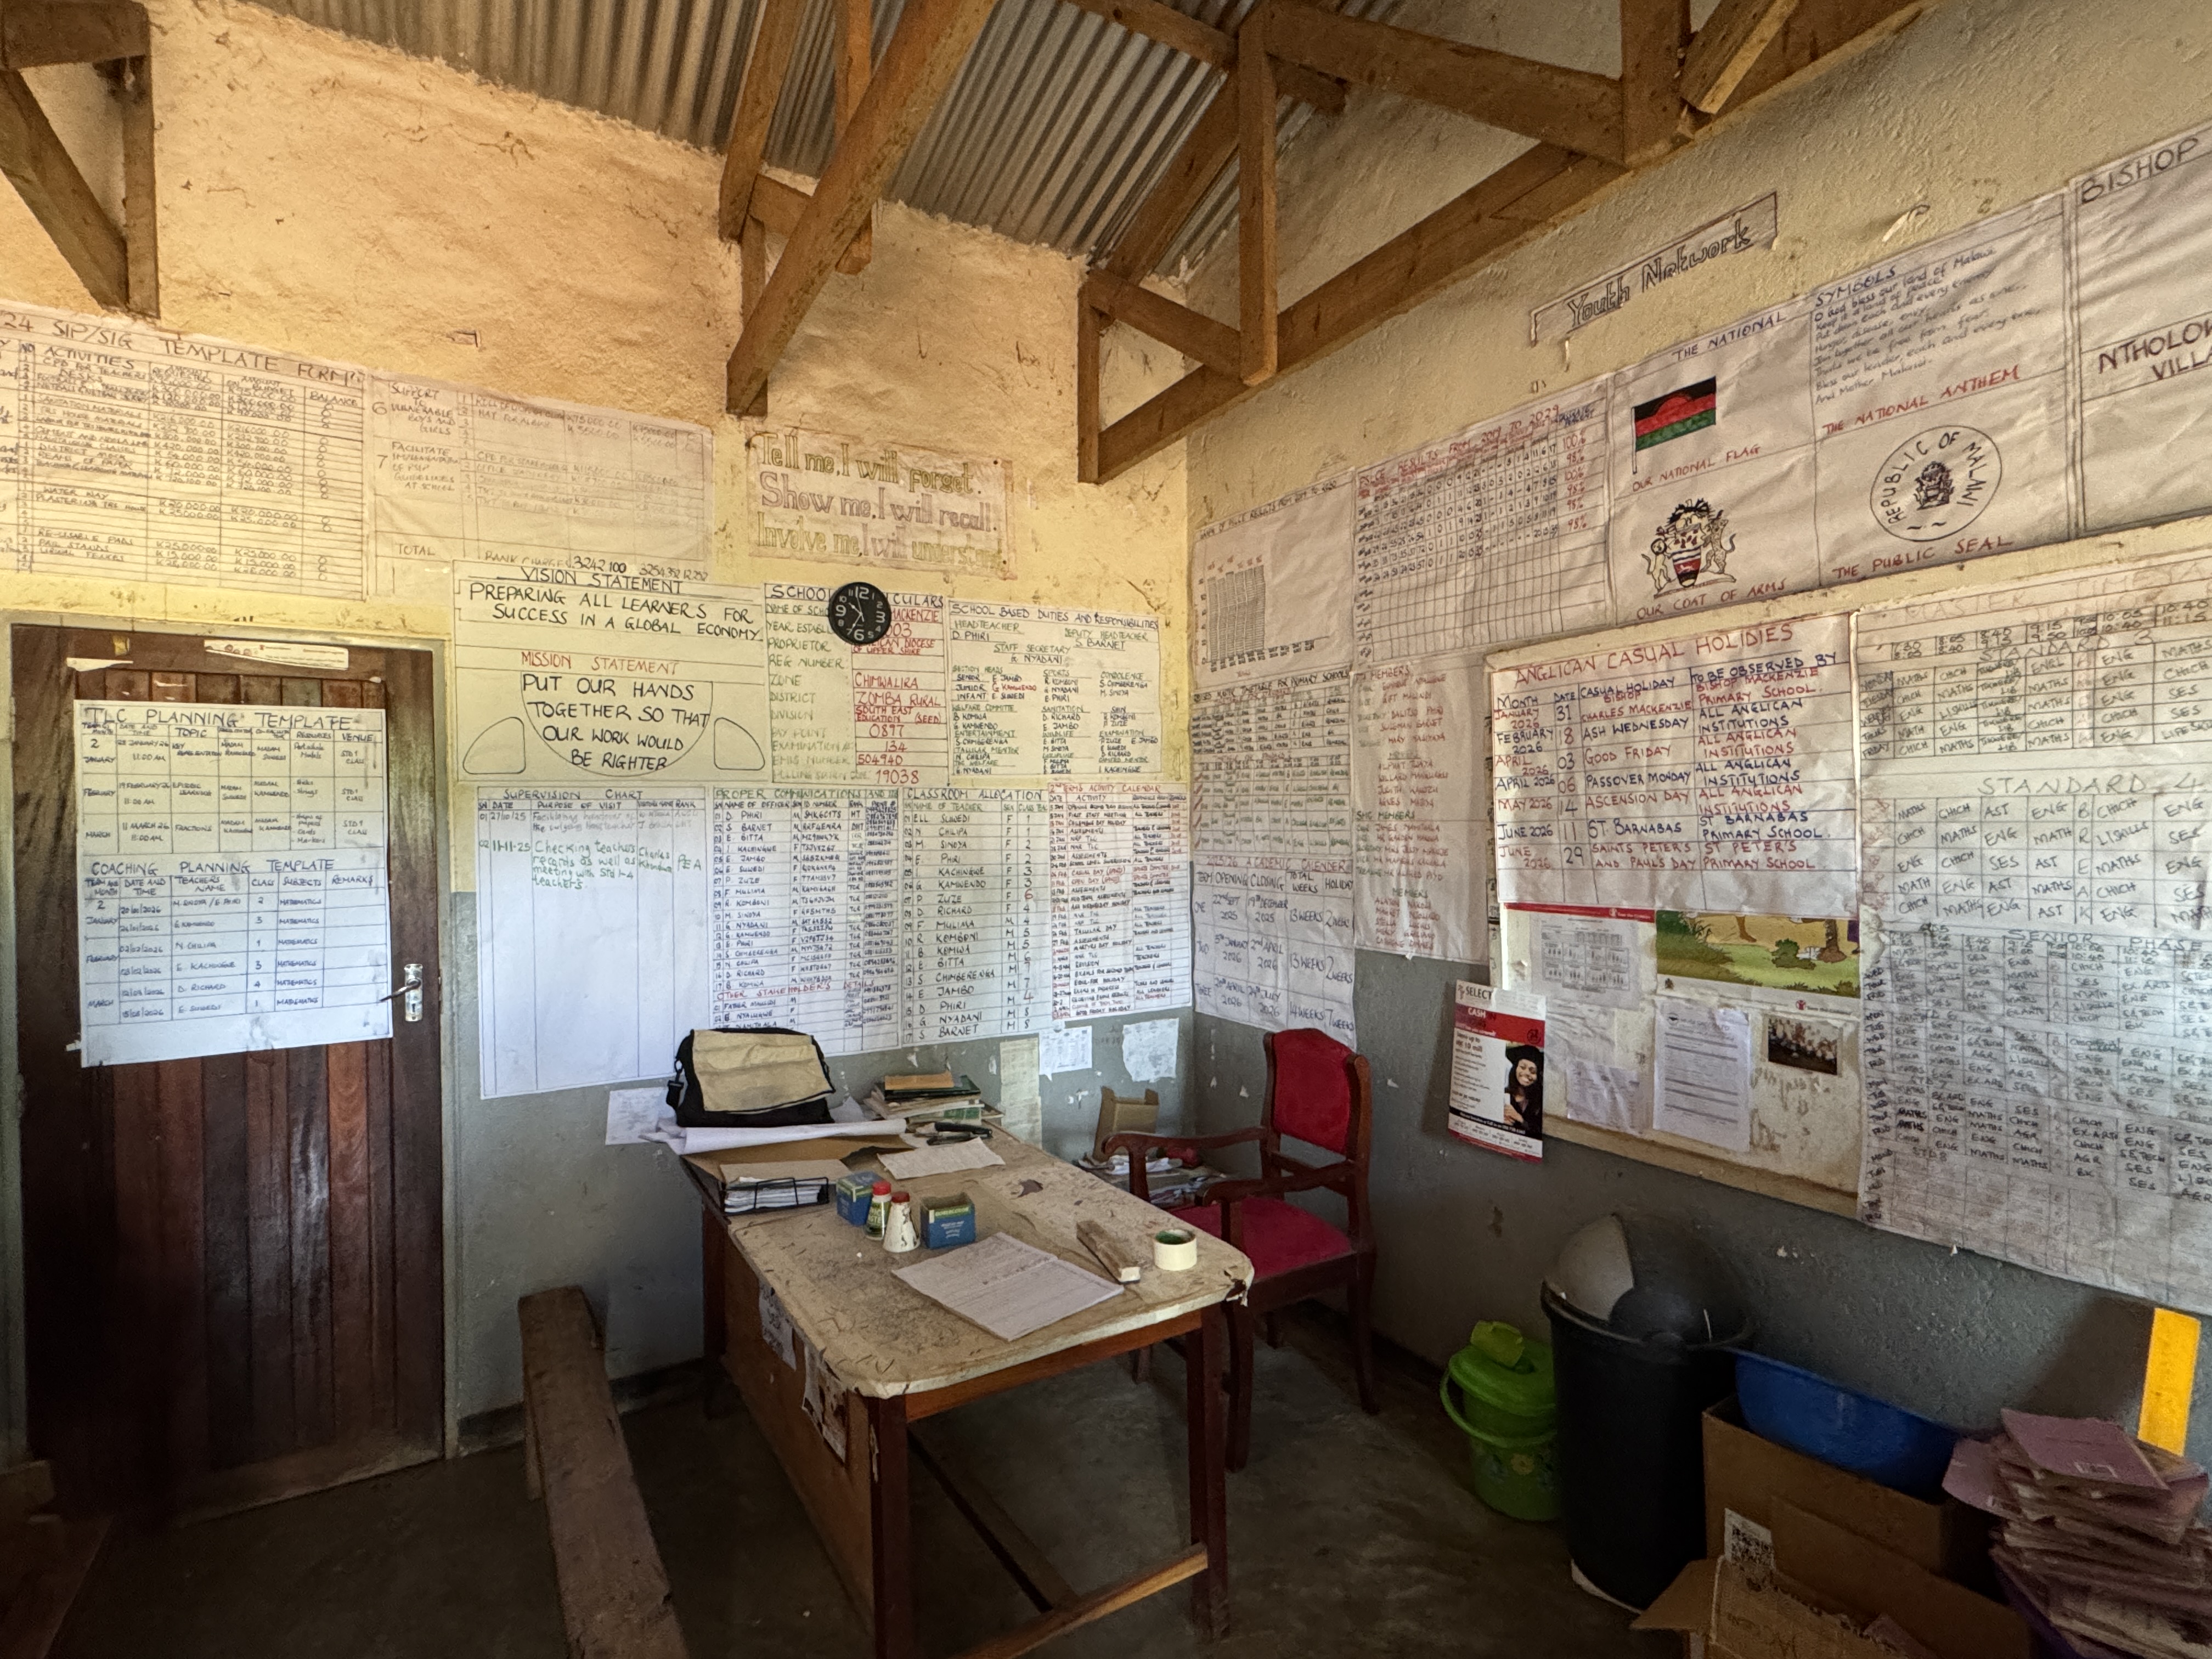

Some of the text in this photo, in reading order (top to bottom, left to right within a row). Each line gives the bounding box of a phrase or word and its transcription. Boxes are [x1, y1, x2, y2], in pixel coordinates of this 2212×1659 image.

[2081, 137, 2198, 204] BISHOP
[1567, 217, 1751, 328] Youth Network
[1672, 265, 1896, 361] THE NATIONAL SYMBOLS
[161, 338, 277, 370] TEMPLATE
[1822, 365, 2020, 435] THE NATIONAL ANTHEM
[757, 432, 800, 470] Tell
[855, 450, 899, 484] will
[1632, 444, 1760, 492] OUR NATIONAL FLAG
[1881, 441, 1929, 523] REPUBLIC
[1938, 431, 1960, 449] OF
[760, 471, 834, 513] Show
[890, 493, 933, 524] will
[1832, 536, 2013, 579] THE PUBLIC SEAL
[521, 566, 683, 594] VISION STATEMENT
[855, 586, 870, 600] 12
[1636, 579, 1787, 620] OUR COAT OF ARMS
[470, 583, 753, 624] PREPARING ALL LEARNERS FOR
[836, 605, 847, 617] 9
[493, 603, 568, 624] SUCCESS
[580, 613, 595, 626] IN
[605, 617, 614, 629] A
[625, 617, 681, 633] GLOBAL
[876, 611, 885, 623] 3
[951, 605, 1158, 630] SCHOOL BASED DUTIES AND RESPONSIBILITIES
[955, 620, 1019, 631] HEADTEACHER
[768, 637, 832, 652] PROPRIETOR
[854, 629, 864, 641] 6
[522, 651, 679, 675] MISSION STATEMENT
[798, 658, 845, 669] NUMBER
[1515, 624, 1793, 689] ANGLICAN CASUAL HOLIDIES
[523, 674, 695, 701] PUT OUR HANDS
[770, 672, 918, 689] ZONE CHIMWALIRA
[1498, 695, 1538, 709] MONTH
[1581, 685, 1619, 698] CASUAL
[1626, 678, 1675, 691] HOLIDAY
[1708, 668, 1724, 681] BE
[1730, 657, 1804, 677] OBSERVED
[1815, 652, 1836, 667] BY
[770, 692, 941, 707] DISTRICT ZOMBA RURAL
[85, 708, 353, 730] TLC PLANNING TEMPLATE
[527, 702, 710, 727] TOGETHER SO THAT
[892, 706, 913, 714] EAST
[915, 713, 941, 724] (SEED)
[1556, 704, 1572, 721] 31
[1629, 701, 1692, 714] MACKENZIE
[175, 728, 374, 741] TOPIC VENUE
[543, 726, 684, 751] OUR WORK WOULD
[870, 724, 904, 737] 0897
[1583, 718, 1689, 740] ASH WEDNESDAY
[885, 741, 908, 752] 134
[1584, 746, 1672, 765] GOOD FRIDAY
[571, 749, 668, 771] BE RIGHTER
[858, 754, 903, 765] 504940
[877, 769, 919, 784] 19038
[1586, 759, 1791, 788] PASSOVER MONDAY ALL ANGLICAN
[1704, 770, 1800, 787] INSTITUTIONS
[1122, 785, 1161, 793] CALENDAR
[1978, 772, 2204, 795] STANDARD 4
[503, 789, 643, 800] SUPERVISION CHART
[715, 789, 861, 799] PROPER COMMUNICATIONS
[907, 788, 1041, 800] CLASSROOM ALLOCATION
[1586, 790, 1690, 809] ASCENSION DAY
[1984, 803, 2009, 819] AST
[1613, 818, 1682, 835] BARNABAS
[1984, 827, 2017, 846] ENG
[91, 859, 335, 876] COACHING PLANNING TEMPLATE
[1989, 855, 2019, 871] SES
[1465, 986, 1492, 1000] SELECT
[1468, 1007, 1486, 1018] CASH
